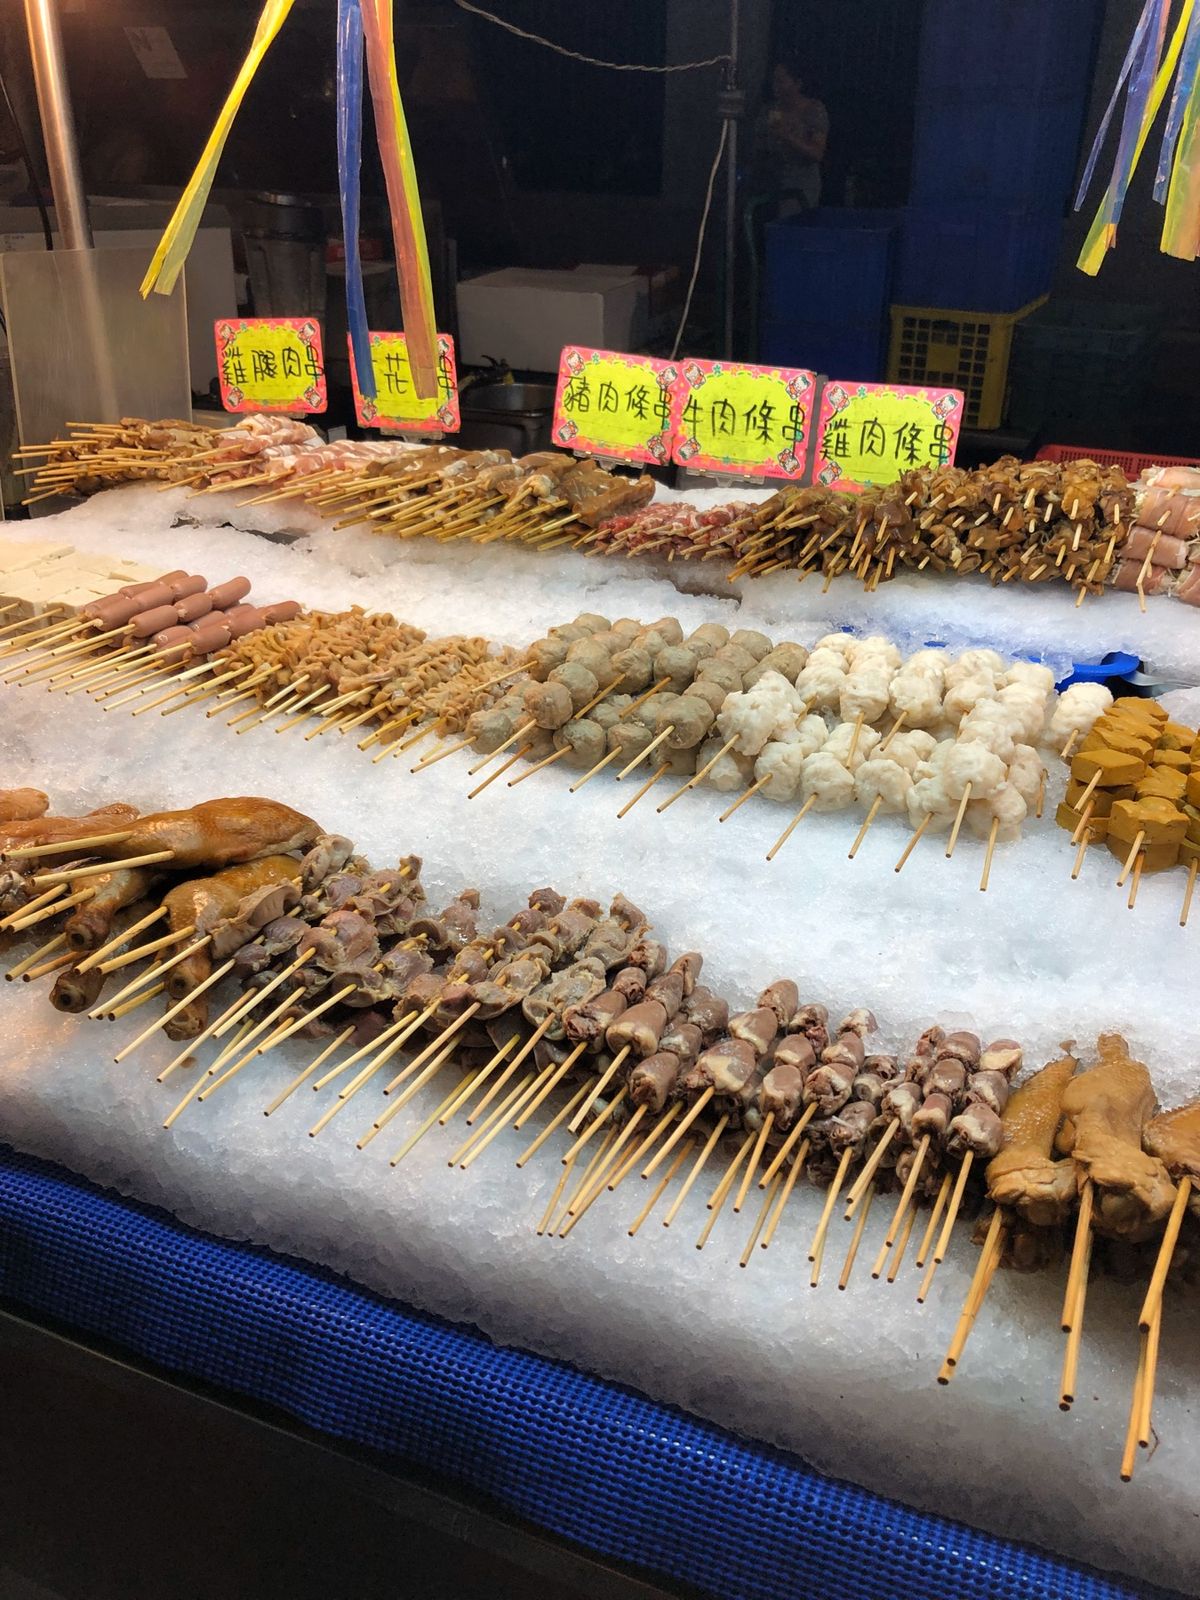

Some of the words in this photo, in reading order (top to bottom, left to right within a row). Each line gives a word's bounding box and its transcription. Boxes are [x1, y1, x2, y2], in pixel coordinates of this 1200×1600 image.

[563, 375, 673, 430] 豬肉條串
[681, 394, 806, 458] 牛肉條串
[819, 410, 954, 468] 雞肉條串
